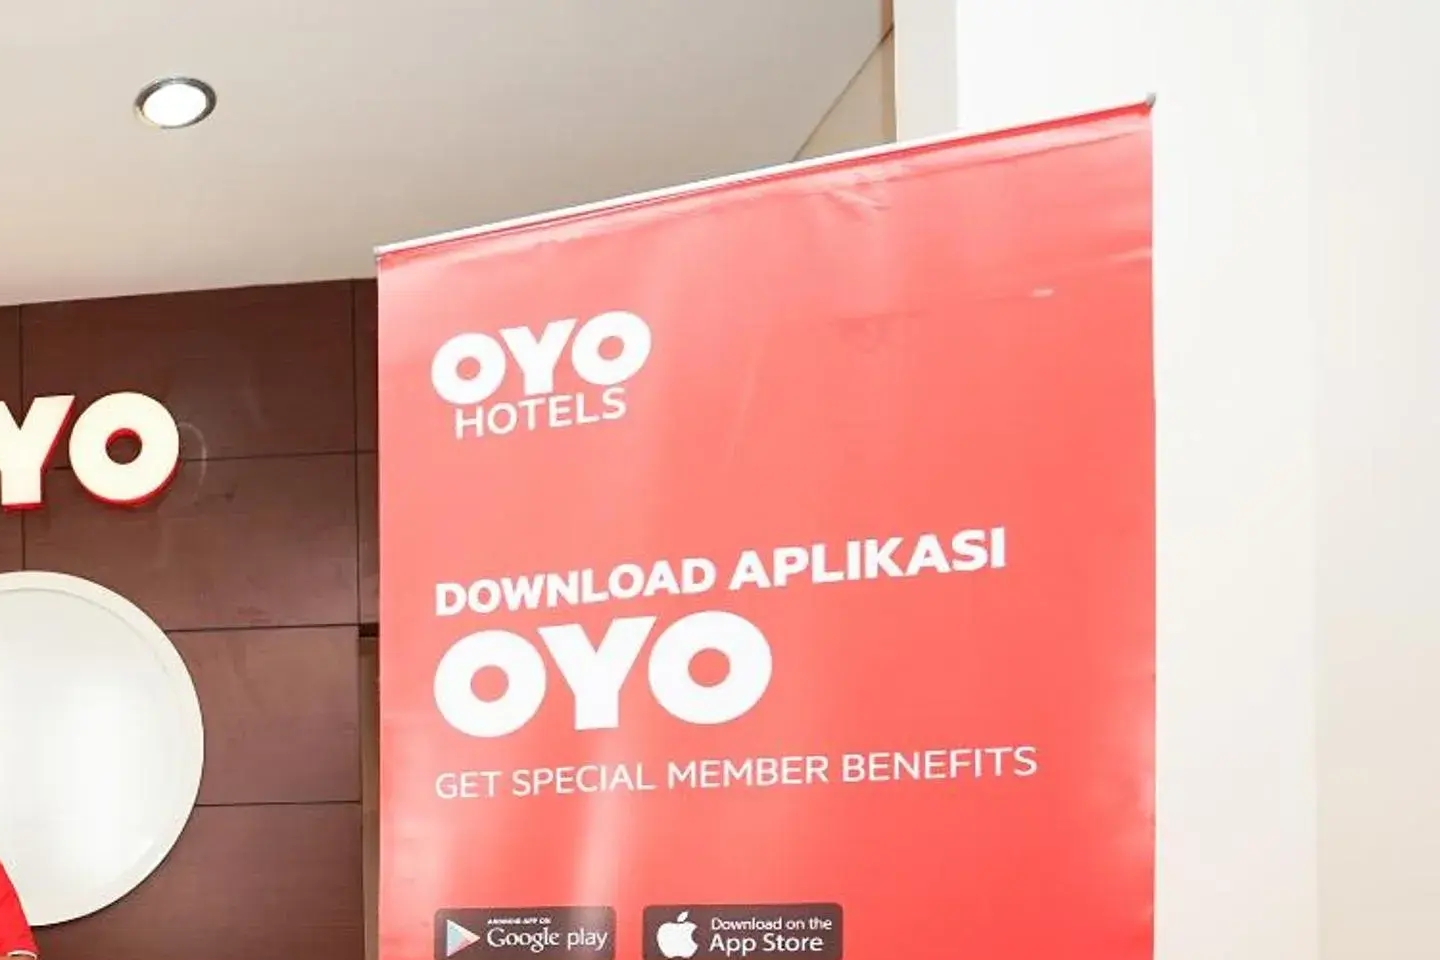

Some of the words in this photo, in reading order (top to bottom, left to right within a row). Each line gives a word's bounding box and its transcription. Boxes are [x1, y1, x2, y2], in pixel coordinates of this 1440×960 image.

[431, 311, 652, 404] OYO
[454, 386, 628, 439] HOTELS
[435, 557, 717, 616] DOWNLOAD
[728, 527, 1006, 590] APLIKASI
[433, 609, 773, 738] OYO
[435, 769, 502, 799] GET
[511, 762, 656, 796] SPECIAL
[667, 754, 829, 790] MEMBER
[842, 745, 1038, 783] BENEFITS
[487, 927, 560, 953] Google
[568, 927, 608, 951] play
[709, 933, 757, 957] App
[762, 932, 824, 951] Store
[711, 916, 782, 930] Download
[785, 919, 806, 930] on
[809, 916, 833, 930] the
